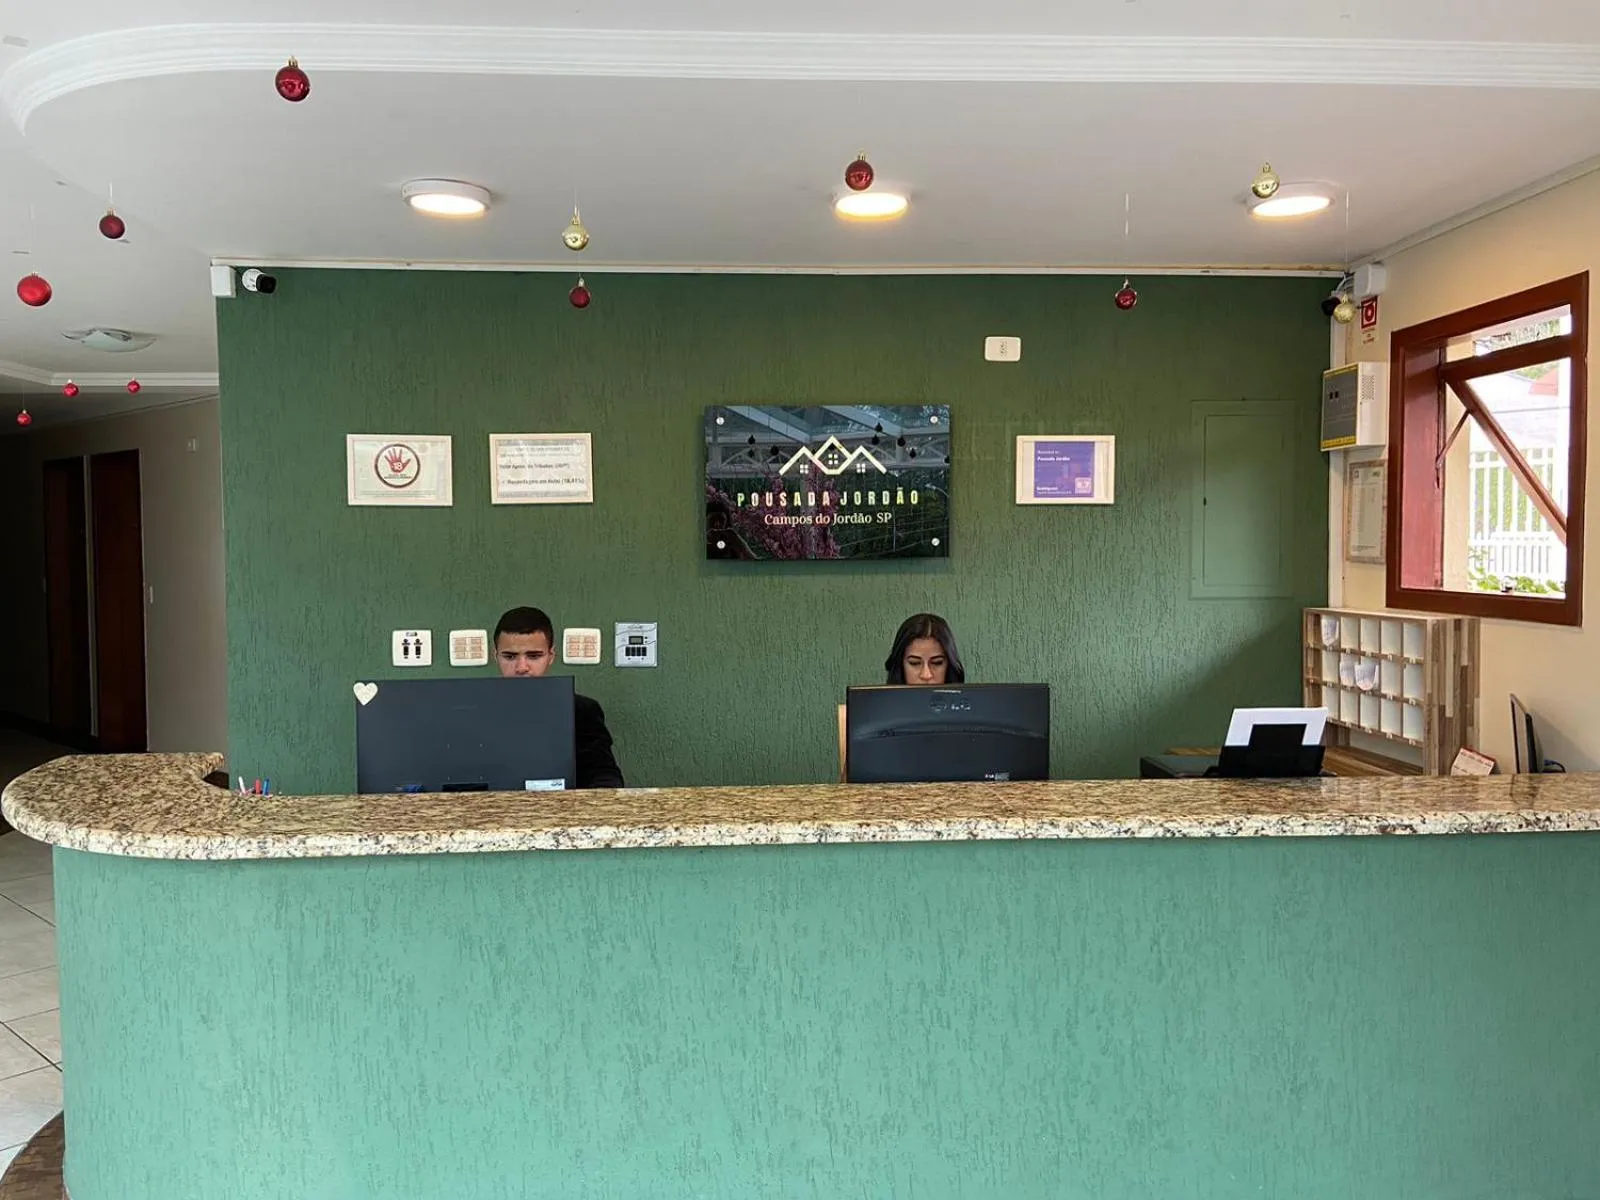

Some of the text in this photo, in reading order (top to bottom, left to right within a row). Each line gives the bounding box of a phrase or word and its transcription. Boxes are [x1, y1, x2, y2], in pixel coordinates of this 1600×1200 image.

[737, 487, 919, 507] POUSADA JORDÃO
[764, 512, 893, 527] Campos do Jordão SP
